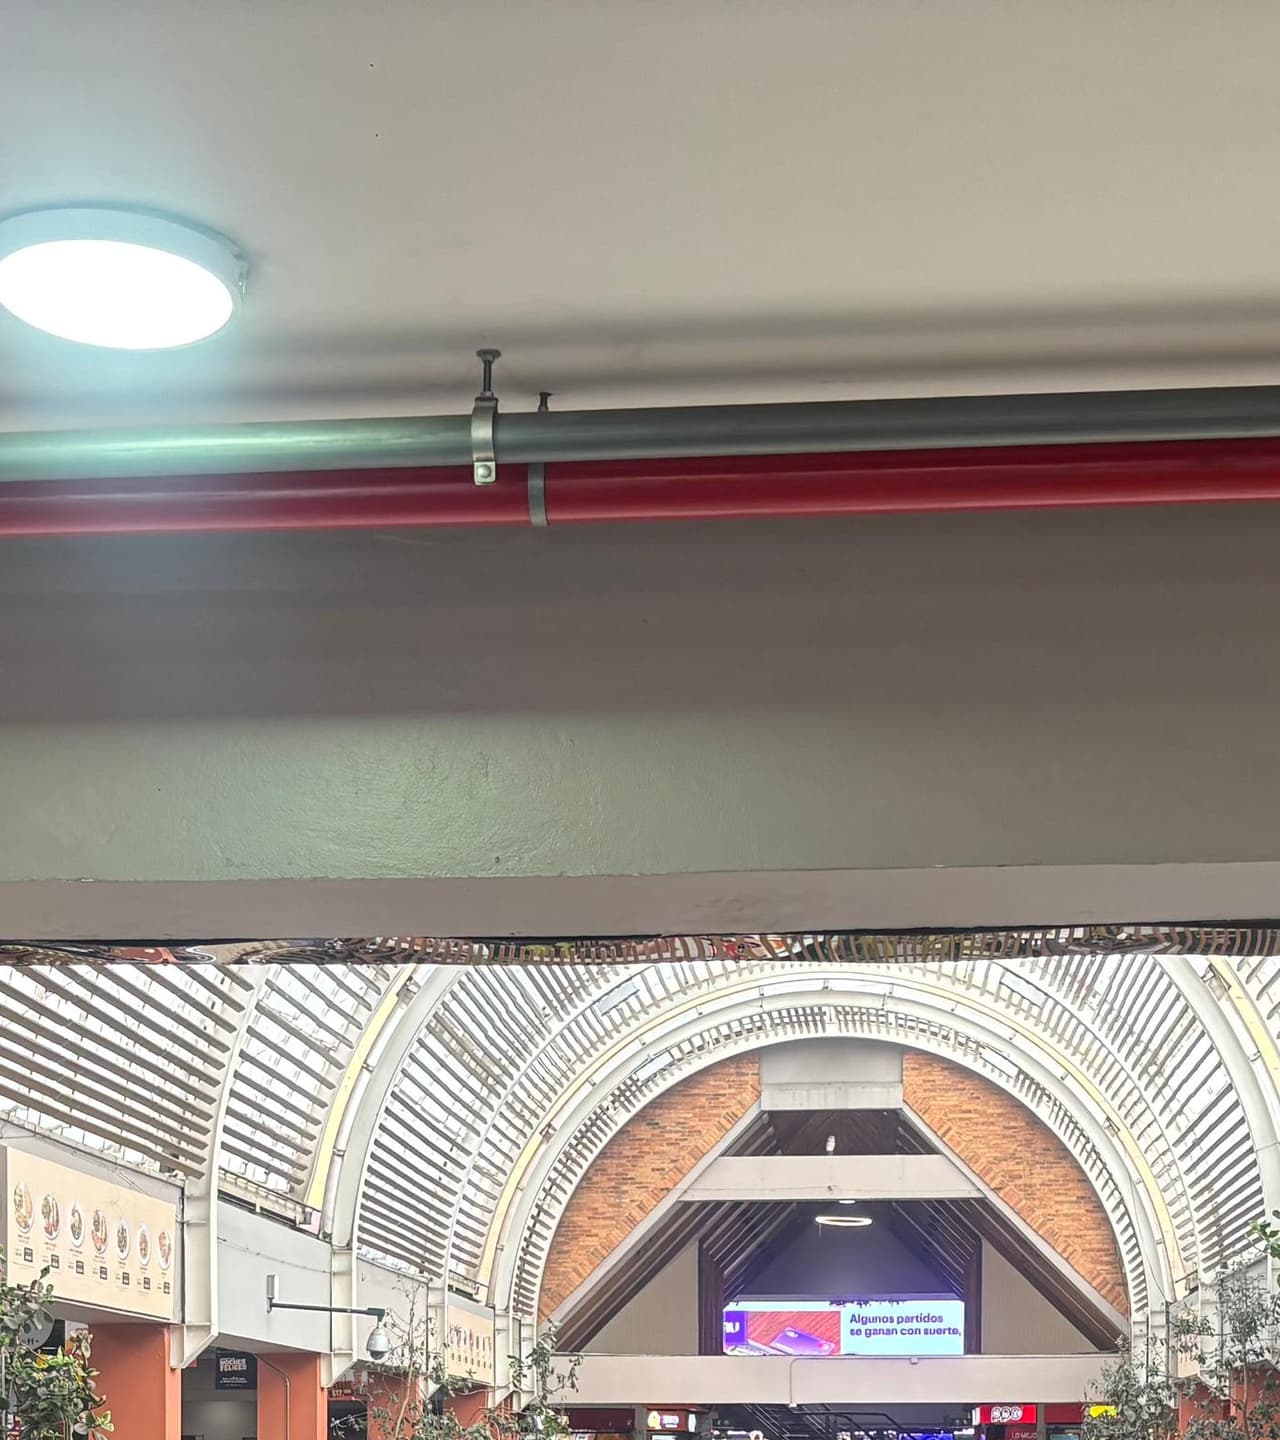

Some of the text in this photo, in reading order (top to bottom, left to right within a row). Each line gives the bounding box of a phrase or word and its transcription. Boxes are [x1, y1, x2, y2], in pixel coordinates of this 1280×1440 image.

[849, 1313, 944, 1326] Algunos partidos
[850, 1327, 862, 1336] se
[865, 1327, 898, 1338] ganan
[901, 1327, 921, 1336] con
